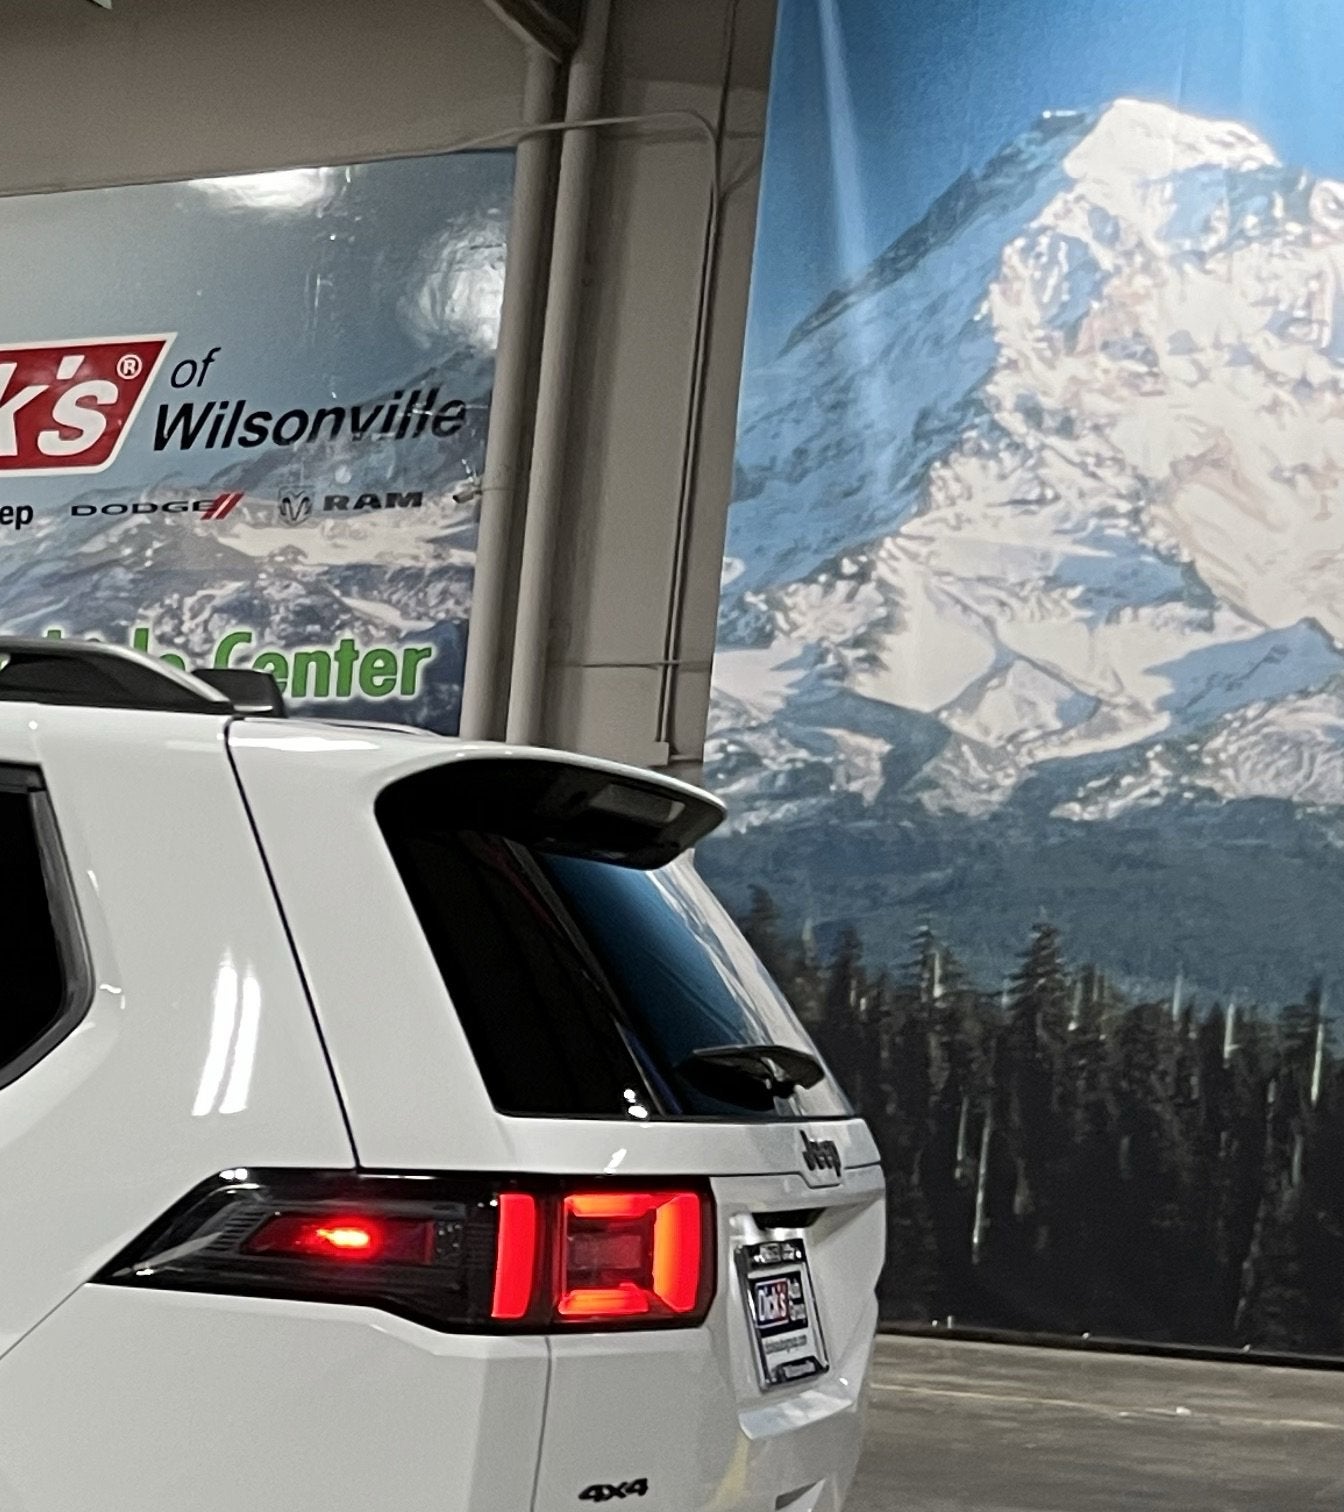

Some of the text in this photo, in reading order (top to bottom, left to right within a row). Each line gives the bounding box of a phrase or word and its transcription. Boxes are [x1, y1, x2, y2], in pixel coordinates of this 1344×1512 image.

[170, 347, 222, 388] of
[153, 384, 467, 451] Wilsonville
[70, 500, 216, 517] DODGE
[322, 491, 424, 511] RAM
[214, 632, 433, 698] Center
